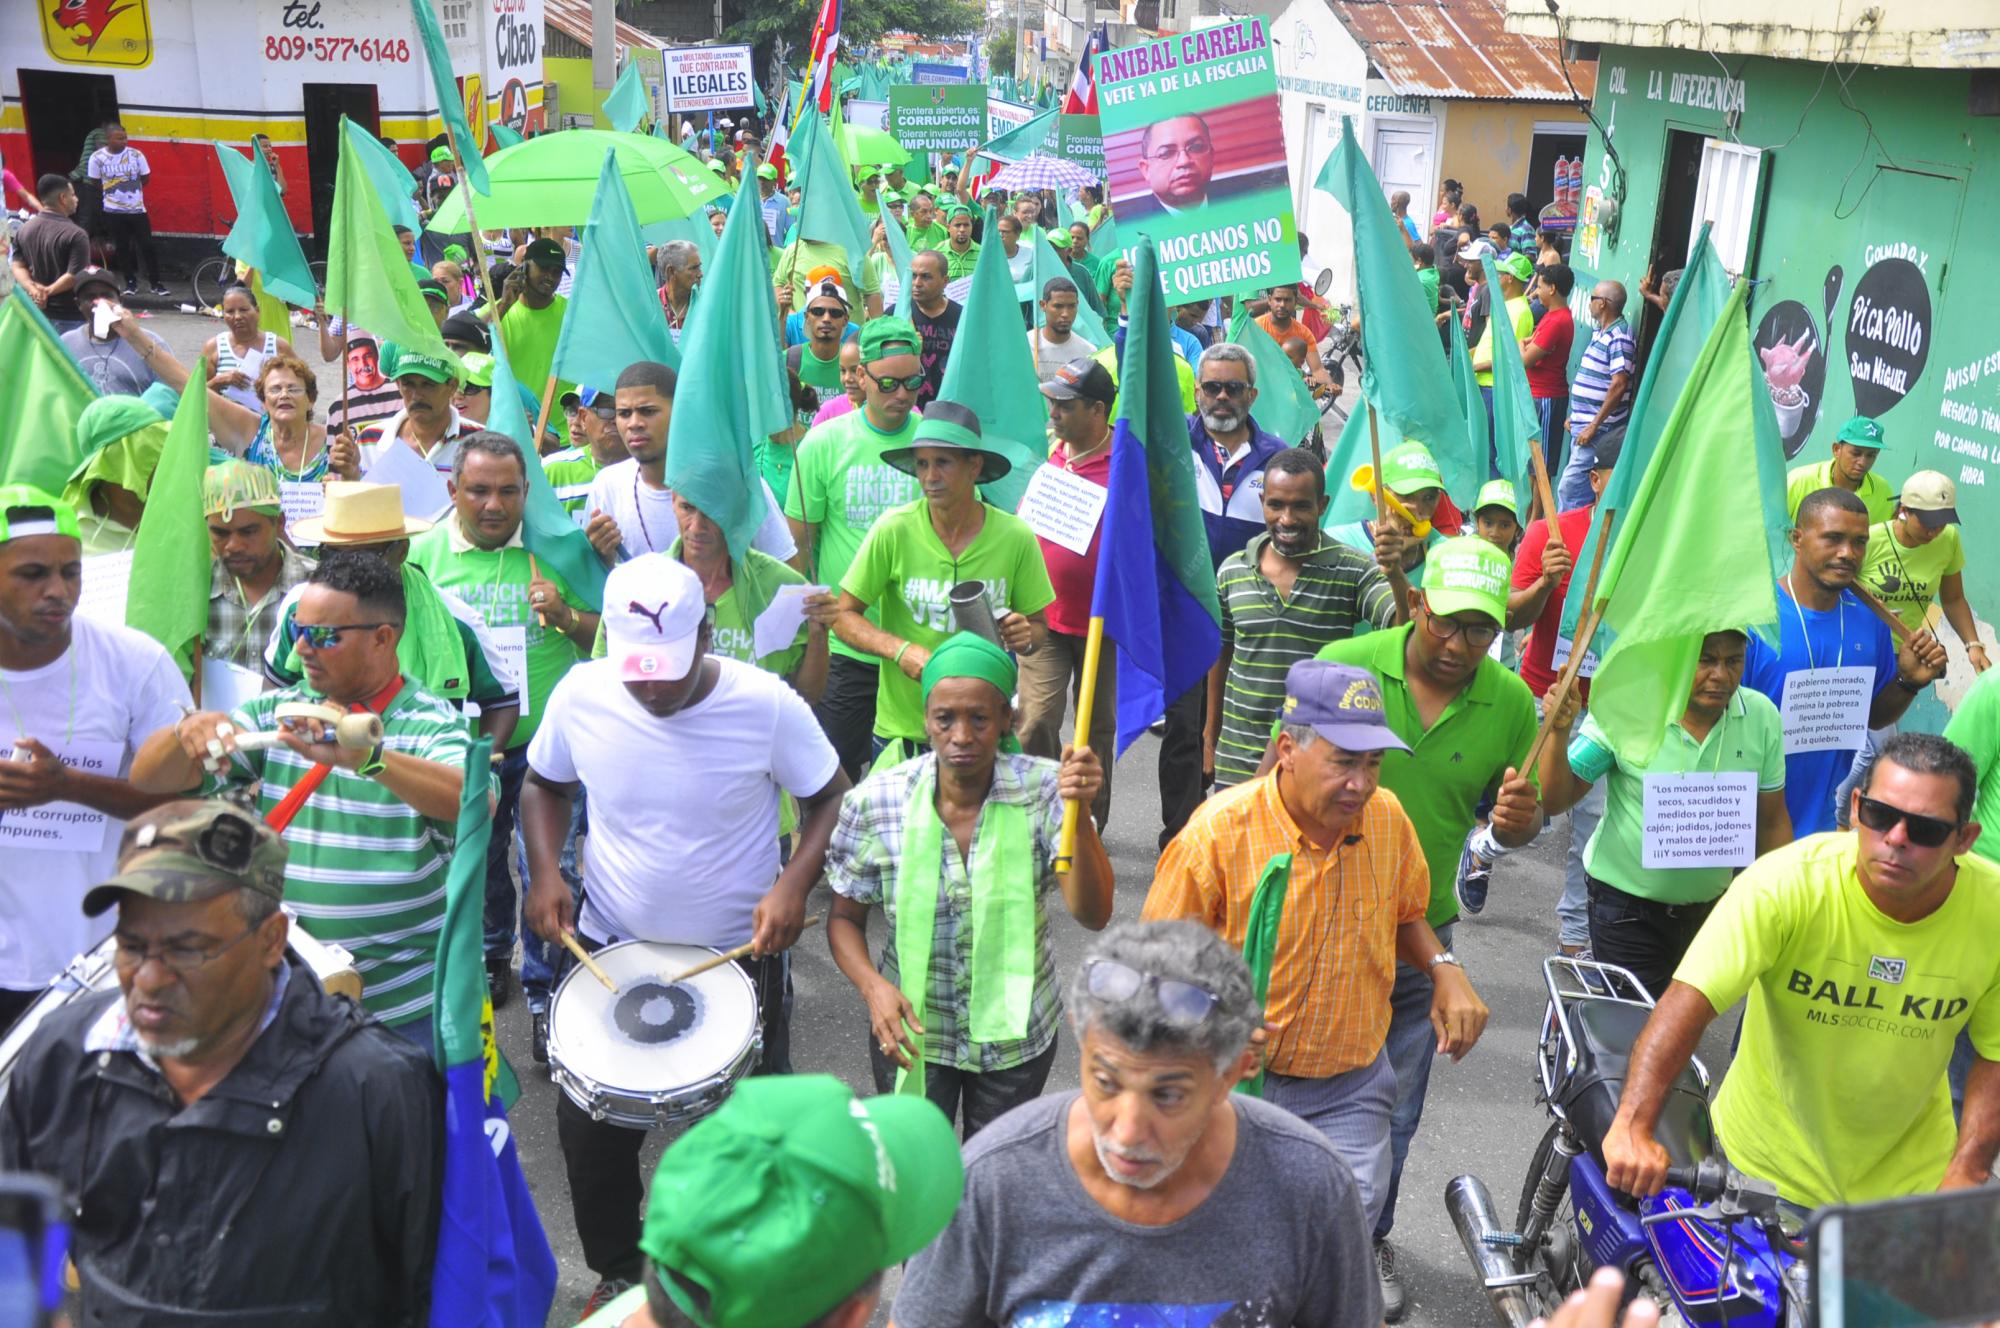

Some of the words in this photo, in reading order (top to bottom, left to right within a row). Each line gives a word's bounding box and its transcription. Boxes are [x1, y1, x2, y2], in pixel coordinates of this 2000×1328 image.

[495, 13, 536, 70] Cibao
[1100, 40, 1178, 85] ANIBAL
[1180, 19, 1267, 66] CARELA
[679, 62, 694, 74] QUE
[695, 60, 738, 72] CONTRATAN
[672, 71, 747, 95] ILEGALES
[1103, 84, 1136, 107] VETE
[1139, 80, 1157, 98] YA
[1160, 75, 1180, 94] DE
[1183, 70, 1202, 88] LA
[1205, 54, 1268, 83] FISCALIA
[1609, 66, 1628, 95] COL.
[1647, 70, 1662, 101] LA
[1669, 72, 1746, 113] DIFERENCIA
[673, 98, 715, 109] DETENDREMOS
[1366, 94, 1431, 115] CEFODENFA
[897, 106, 934, 115] Frontera
[935, 106, 966, 115] abierta
[898, 113, 980, 126] CORRUPCIÓN
[896, 129, 928, 138] Tolerar
[929, 128, 966, 138] invasión
[900, 138, 979, 150] IMPUNIDAD
[1159, 223, 1249, 265] MOCANOS
[1253, 217, 1282, 245] NO
[1174, 250, 1272, 295] QUEREMOS
[1851, 351, 1871, 381] San
[1934, 429, 1951, 450] POR
[1951, 436, 1988, 461] CAMARA
[1960, 464, 1985, 486] HORA
[1789, 681, 1796, 689] El
[1796, 678, 1831, 690] gobierno
[1831, 676, 1867, 686] morado,
[1789, 690, 1821, 700] corrupto
[1829, 688, 1863, 698] impune,
[1789, 700, 1816, 712] elimina
[1817, 700, 1825, 709] la
[1826, 699, 1860, 710] pobreza
[1799, 712, 1831, 722] llevando
[1832, 711, 1845, 720] los
[1815, 723, 1865, 734] productores
[1809, 736, 1842, 745] quiebra.
[82, 756, 103, 769] los
[1652, 784, 1672, 794] "Los
[1673, 784, 1715, 793] mocanos
[1716, 784, 1748, 792] somos
[1658, 798, 1685, 807] secos,
[1687, 796, 1733, 806] sacudidos
[1734, 798, 1741, 806] y
[32, 810, 104, 825] corruptos
[1657, 810, 1697, 819] medidos
[1698, 811, 1714, 819] por
[1716, 808, 1741, 818] buen
[1646, 823, 1674, 834] cajón;
[1675, 822, 1713, 833] jodidos,
[1714, 821, 1752, 832] jodones
[1658, 838, 1664, 846] y
[1665, 835, 1694, 845] malos
[1695, 834, 1707, 844] de
[1708, 833, 1740, 845] joder."
[1671, 849, 1702, 857] somos
[1703, 846, 1745, 857] verdes!!!
[1787, 968, 1885, 1010] BALL
[1900, 993, 1969, 1022] KID
[1805, 1008, 1937, 1041] MLSSOCCER.COM
